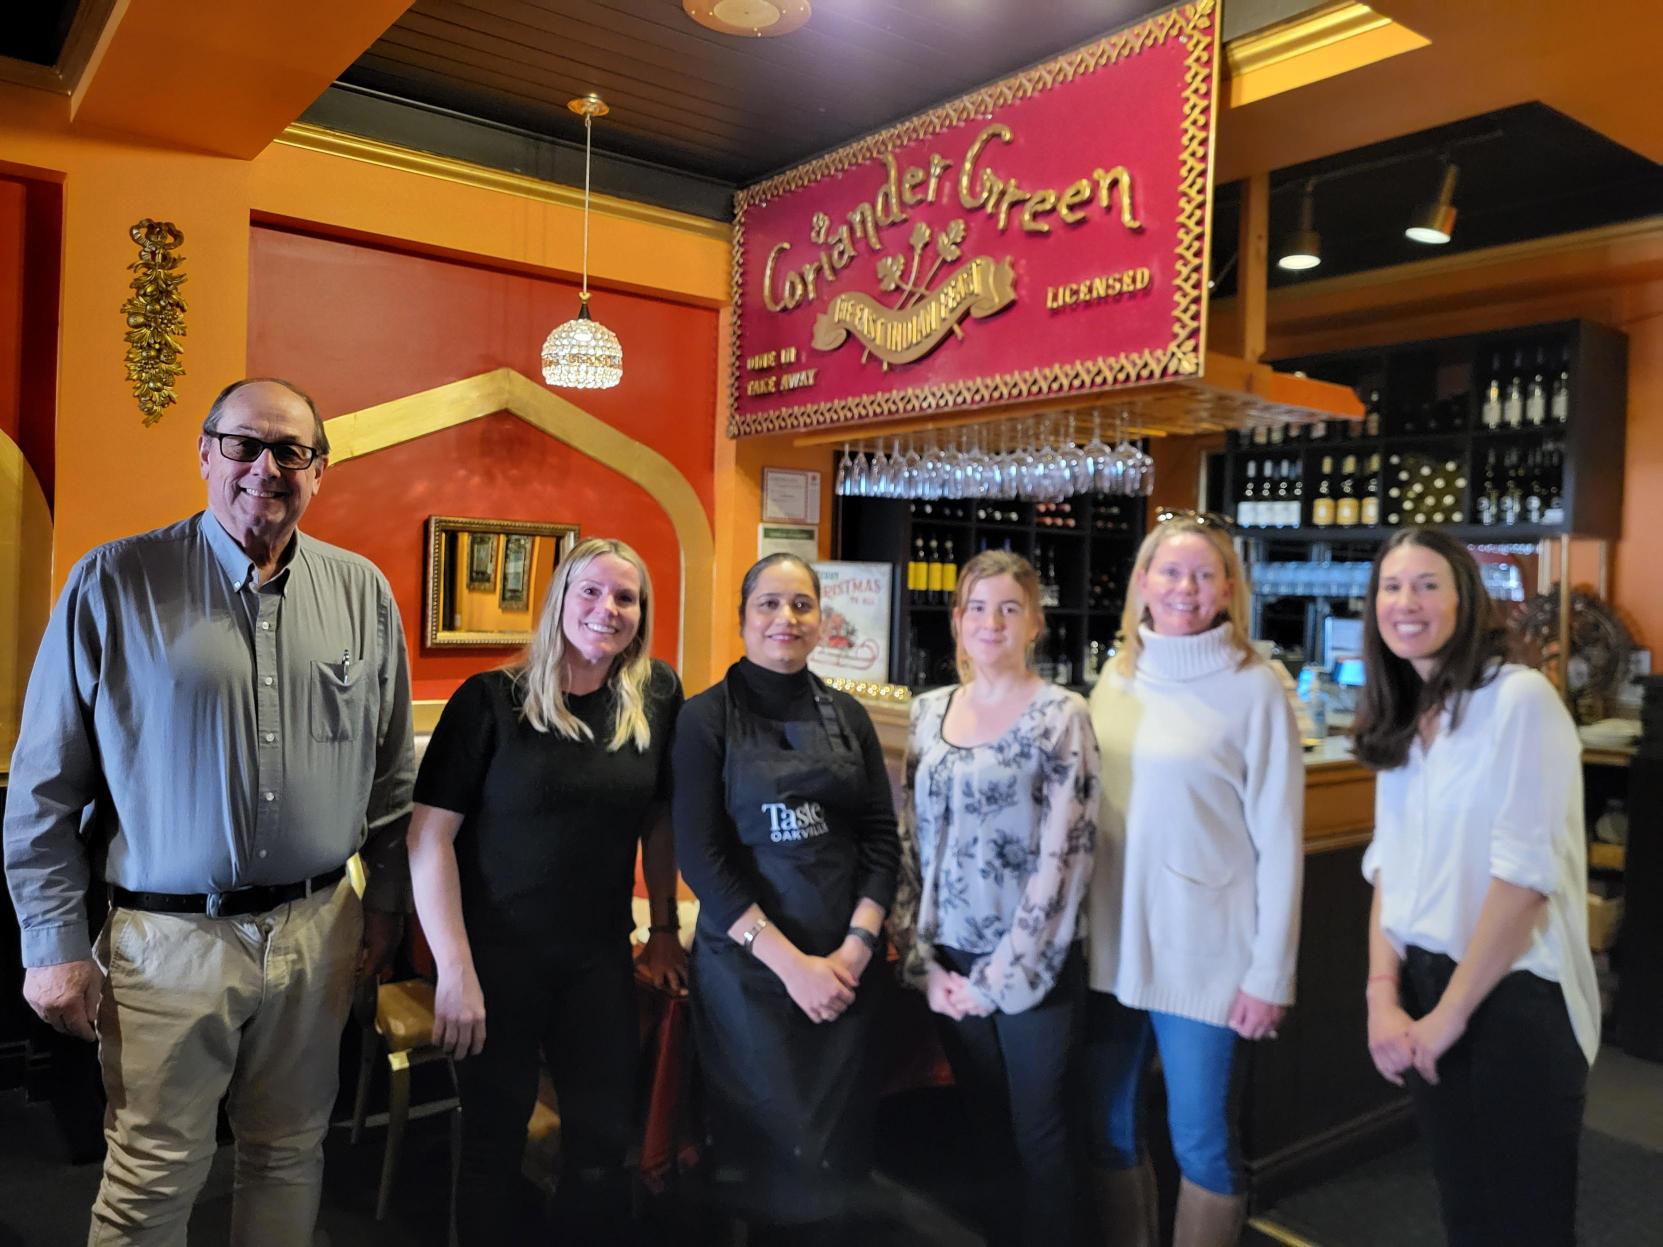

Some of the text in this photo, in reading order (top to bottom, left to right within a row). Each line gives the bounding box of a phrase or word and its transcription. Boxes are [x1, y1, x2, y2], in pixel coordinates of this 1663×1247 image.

[763, 123, 1142, 312] Coriander Green
[1046, 267, 1150, 309] LICENSED
[747, 368, 818, 396] TAKE AWAY
[822, 578, 881, 598] RISTMAS
